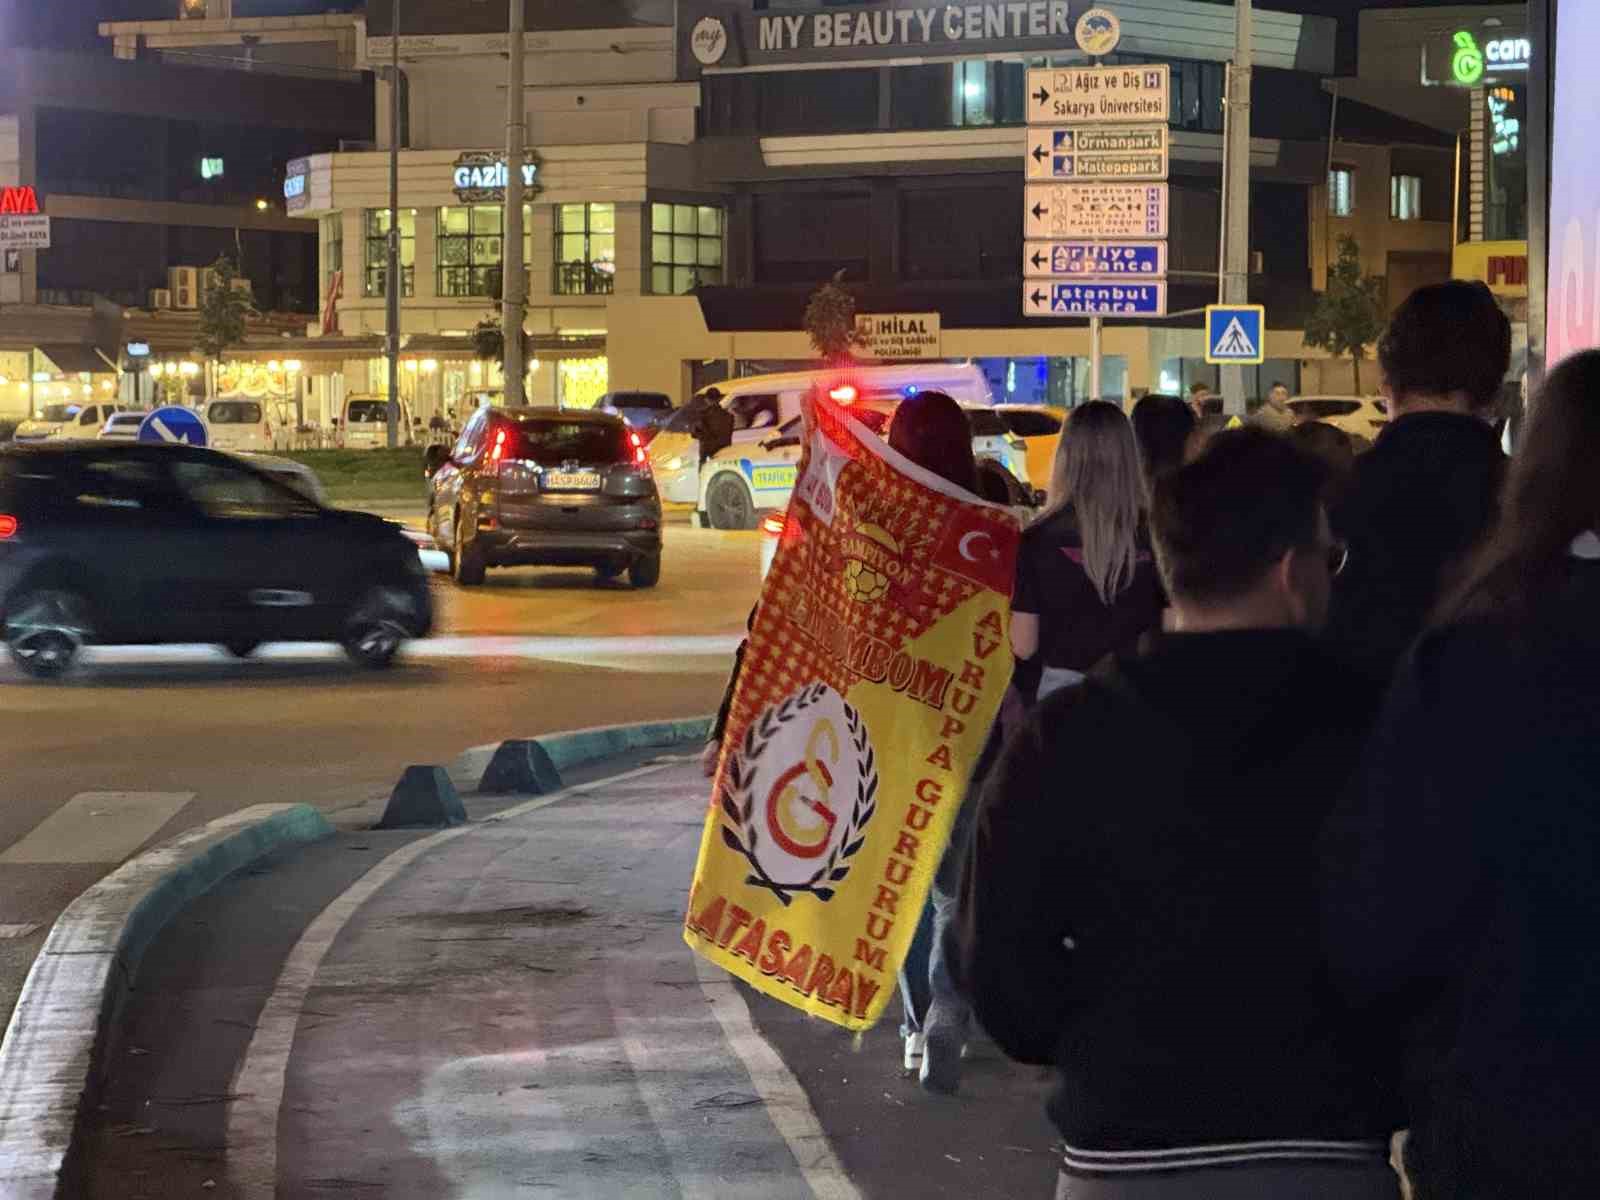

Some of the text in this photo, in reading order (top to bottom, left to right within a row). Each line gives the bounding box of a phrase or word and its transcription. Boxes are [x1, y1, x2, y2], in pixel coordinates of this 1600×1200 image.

[759, 1, 1070, 50] MY BEAUTY CENTER
[1485, 38, 1531, 61] can
[1075, 73, 1099, 92] Ağız
[1104, 77, 1117, 88] ve
[1123, 72, 1141, 91] Diş
[1053, 96, 1162, 116] Sakarya Üniversitesi
[1078, 137, 1160, 151] Ormanpark
[454, 161, 537, 188] GAZİY
[1078, 158, 1160, 174] Maltepepark
[1054, 260, 1153, 273] Sapanca
[1054, 299, 1137, 313] Ankara
[881, 315, 928, 334] HİLAL
[852, 609, 1004, 973] AVRUPA GURURUM
